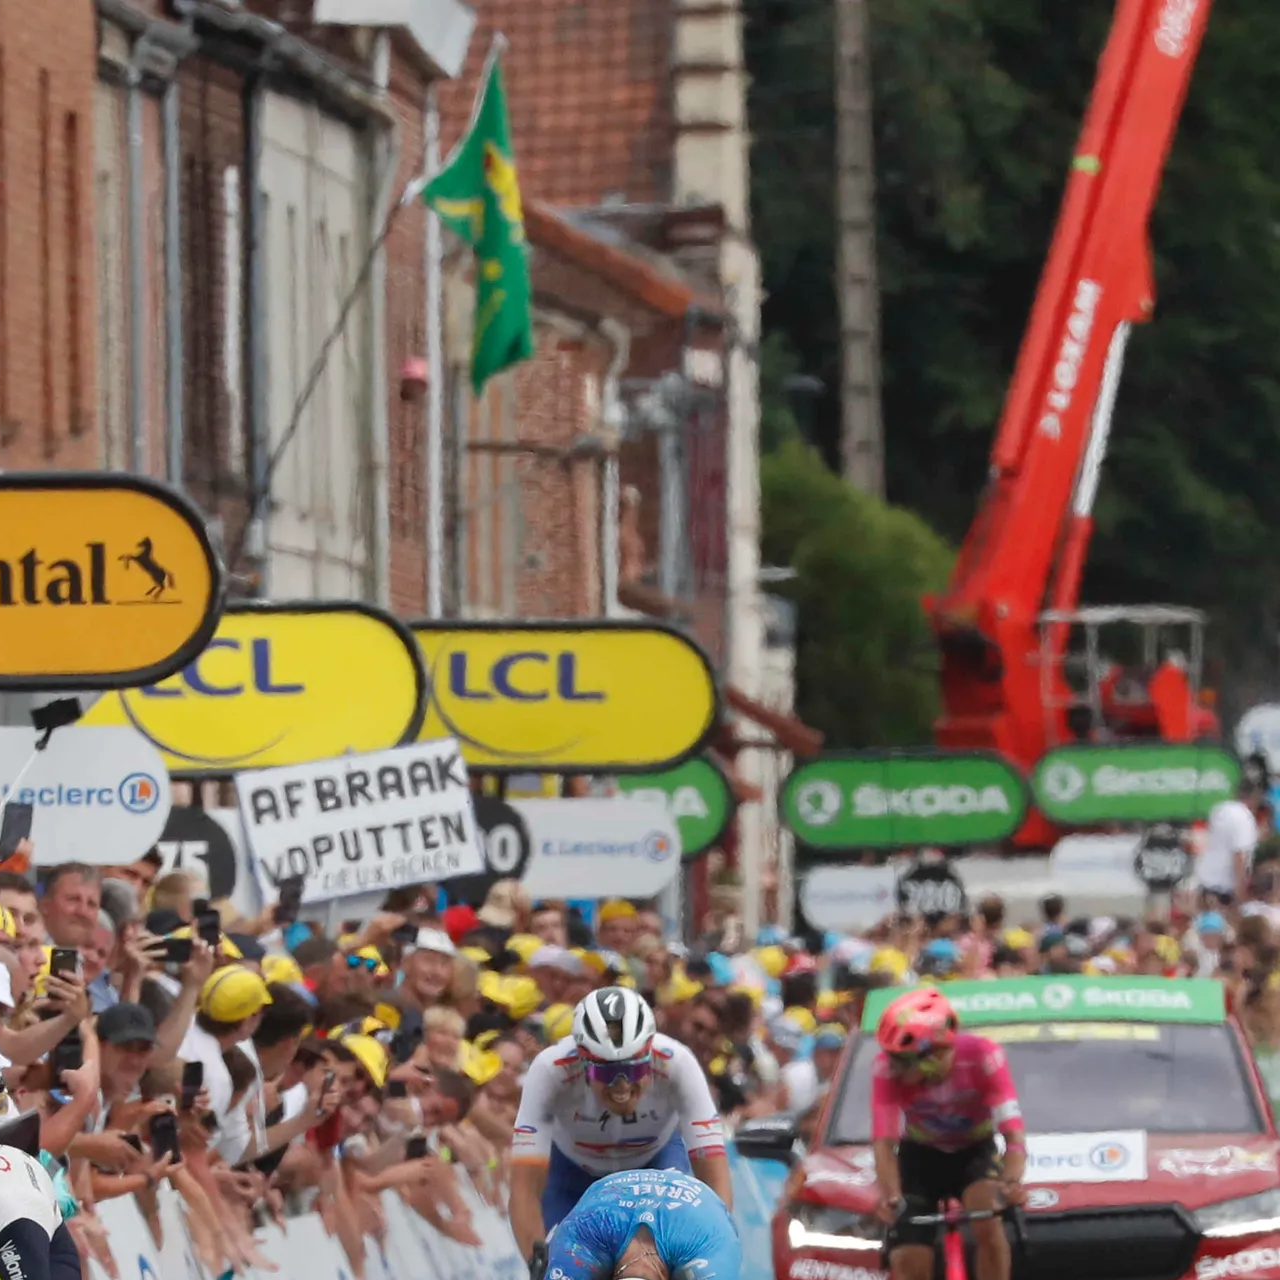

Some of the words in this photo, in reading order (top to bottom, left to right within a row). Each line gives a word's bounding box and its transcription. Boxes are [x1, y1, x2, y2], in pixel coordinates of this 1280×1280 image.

[448, 651, 606, 701] LCL
[250, 752, 466, 825] AFBRAAK
[632, 1184, 702, 1208] ISRAEL
